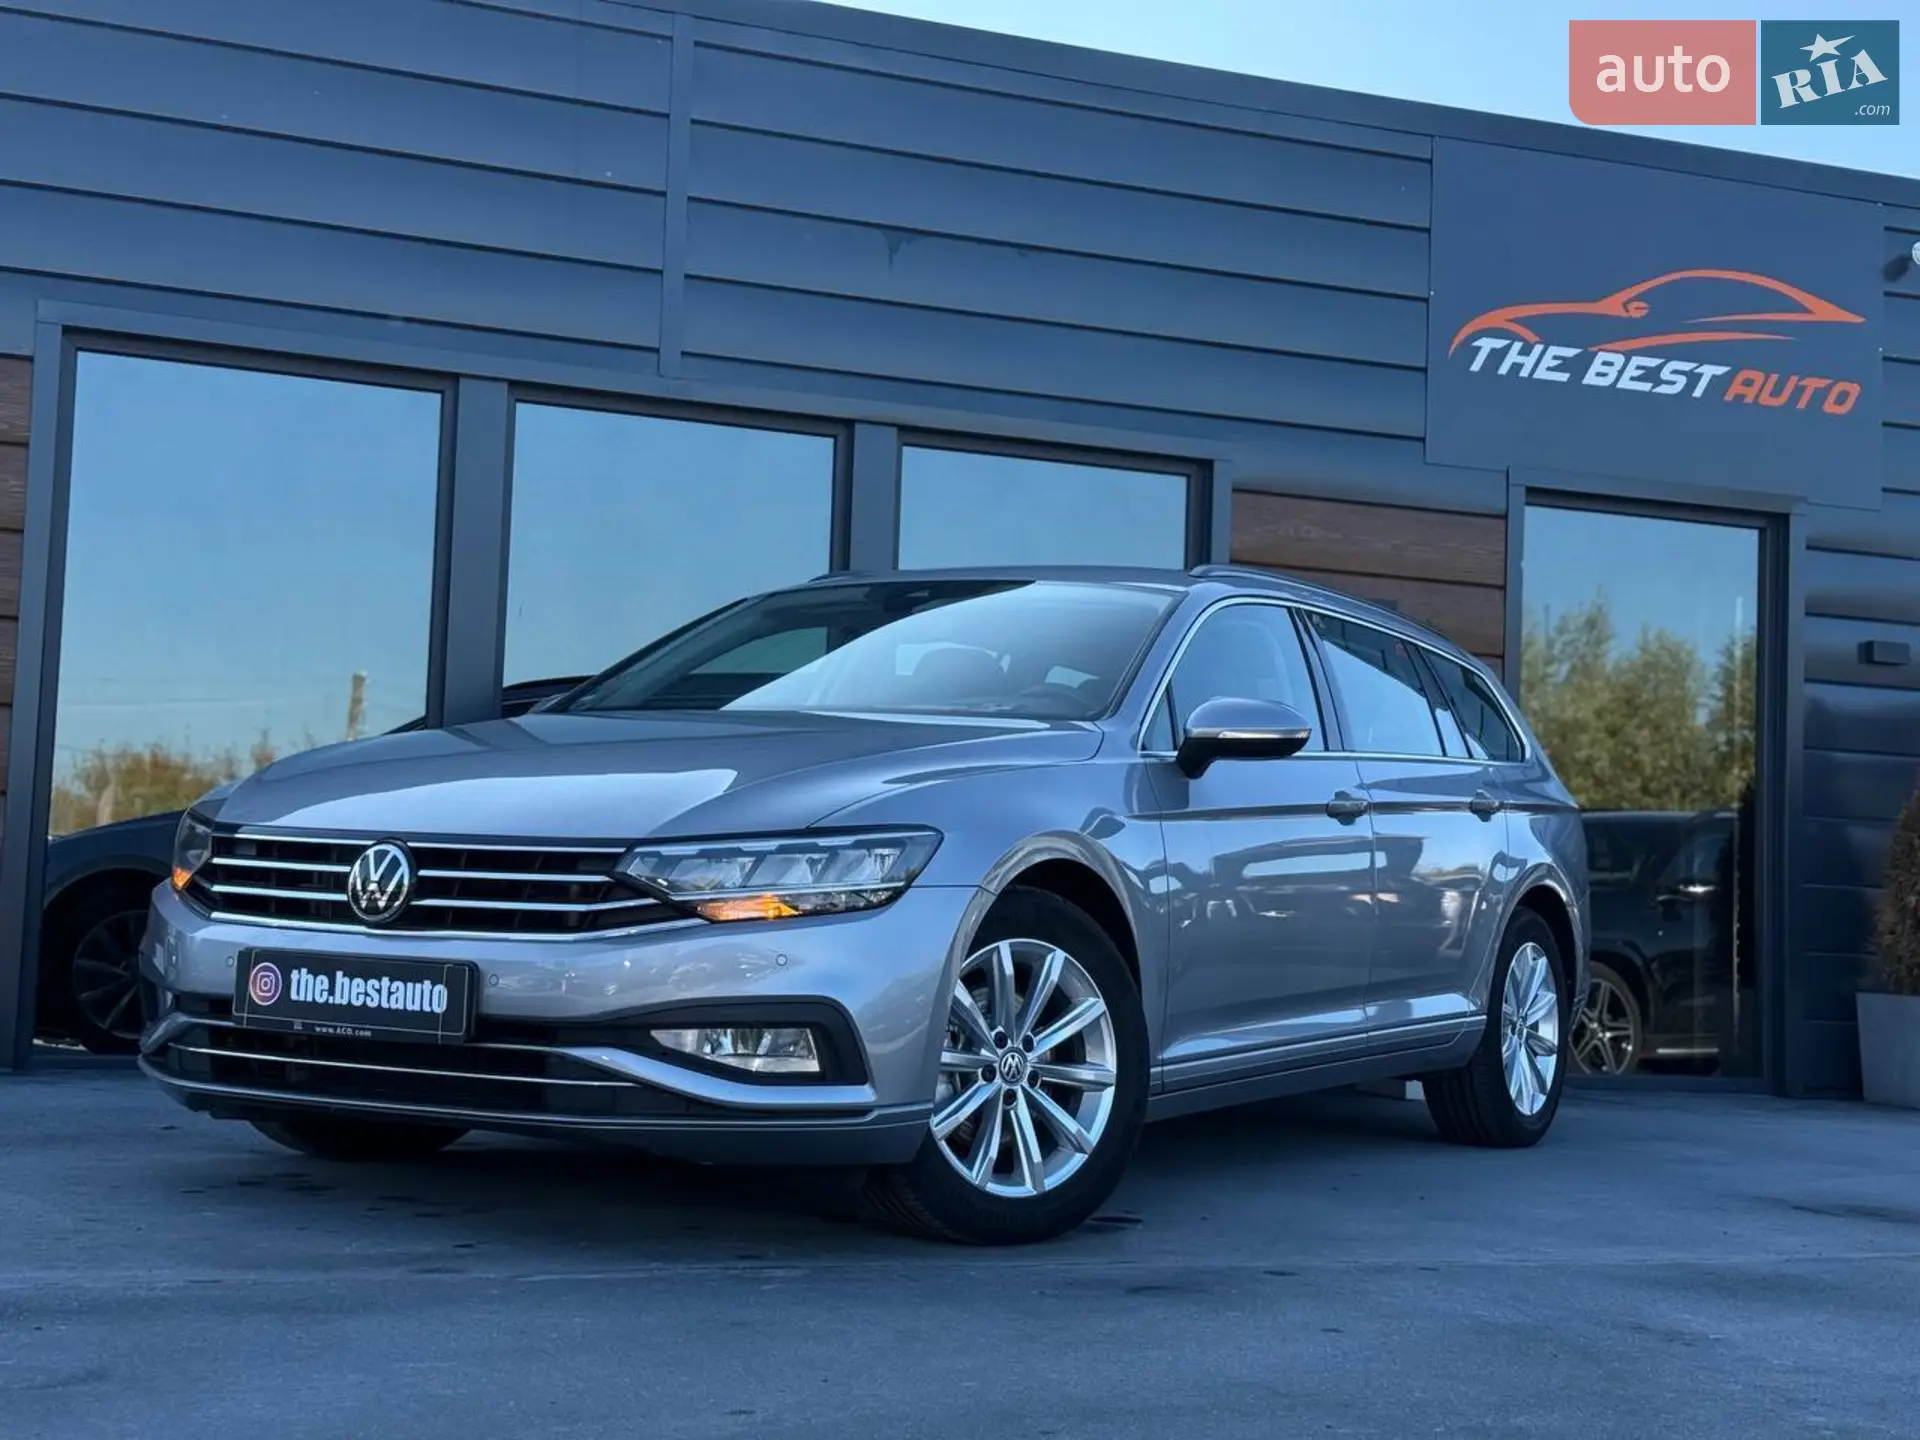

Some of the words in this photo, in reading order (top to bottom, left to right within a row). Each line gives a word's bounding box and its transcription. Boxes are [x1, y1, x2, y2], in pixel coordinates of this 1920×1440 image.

[1469, 337, 1583, 383] THE
[1582, 352, 1732, 398] BEST
[1723, 370, 1861, 415] AUTO
[290, 967, 448, 1014] the.bestauto
